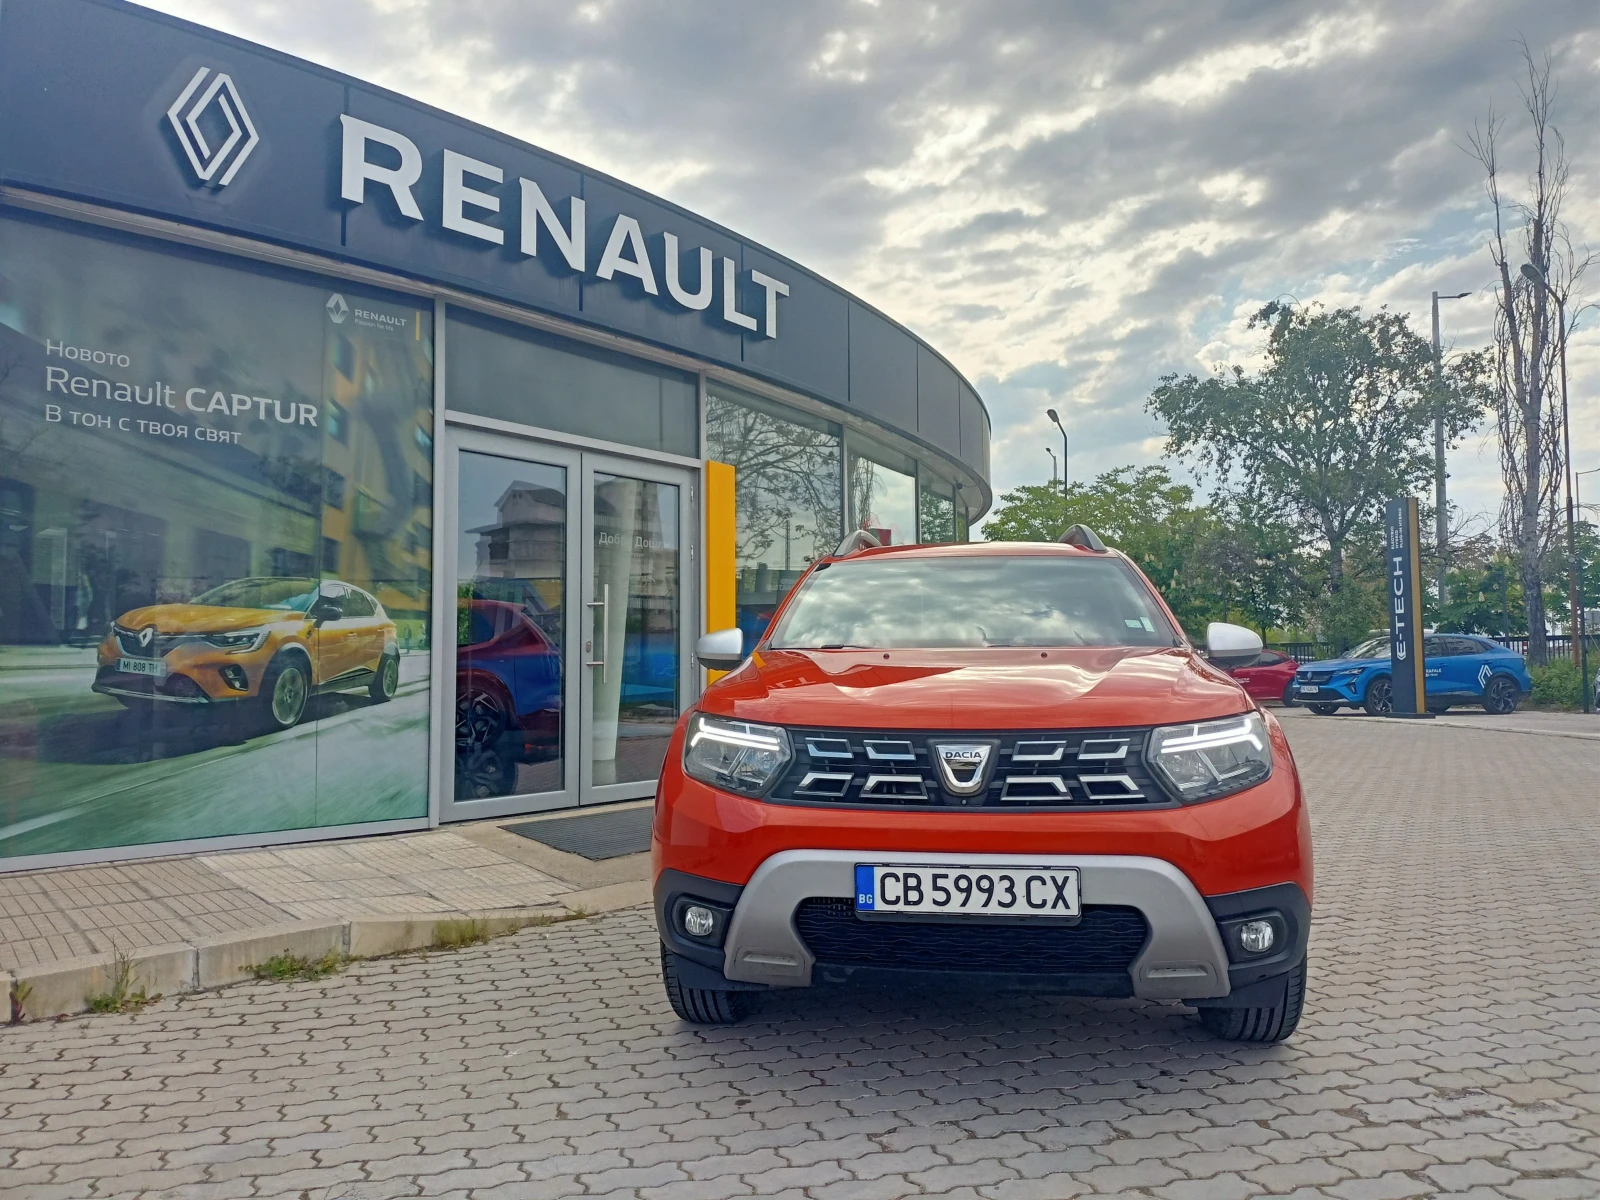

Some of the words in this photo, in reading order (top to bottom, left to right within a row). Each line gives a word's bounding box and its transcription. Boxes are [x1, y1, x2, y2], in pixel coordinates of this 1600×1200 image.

[341, 113, 790, 339] RENAULT
[354, 309, 407, 327] RENAULT
[354, 318, 376, 328] Passion
[385, 324, 395, 332] life
[46, 338, 130, 368] Новото
[45, 366, 176, 409] Renault
[185, 387, 318, 427] CAPTUR
[45, 404, 62, 422] В
[68, 411, 111, 429] тон
[118, 416, 131, 431] с
[137, 419, 188, 438] твоя
[194, 427, 242, 445] свят
[1393, 556, 1406, 660] E-TECH
[133, 662, 146, 672] 808
[945, 751, 982, 759] DACIA
[858, 893, 873, 904] BG
[879, 872, 924, 906] CB
[931, 873, 1017, 908] 5993
[1025, 875, 1071, 910] CX
